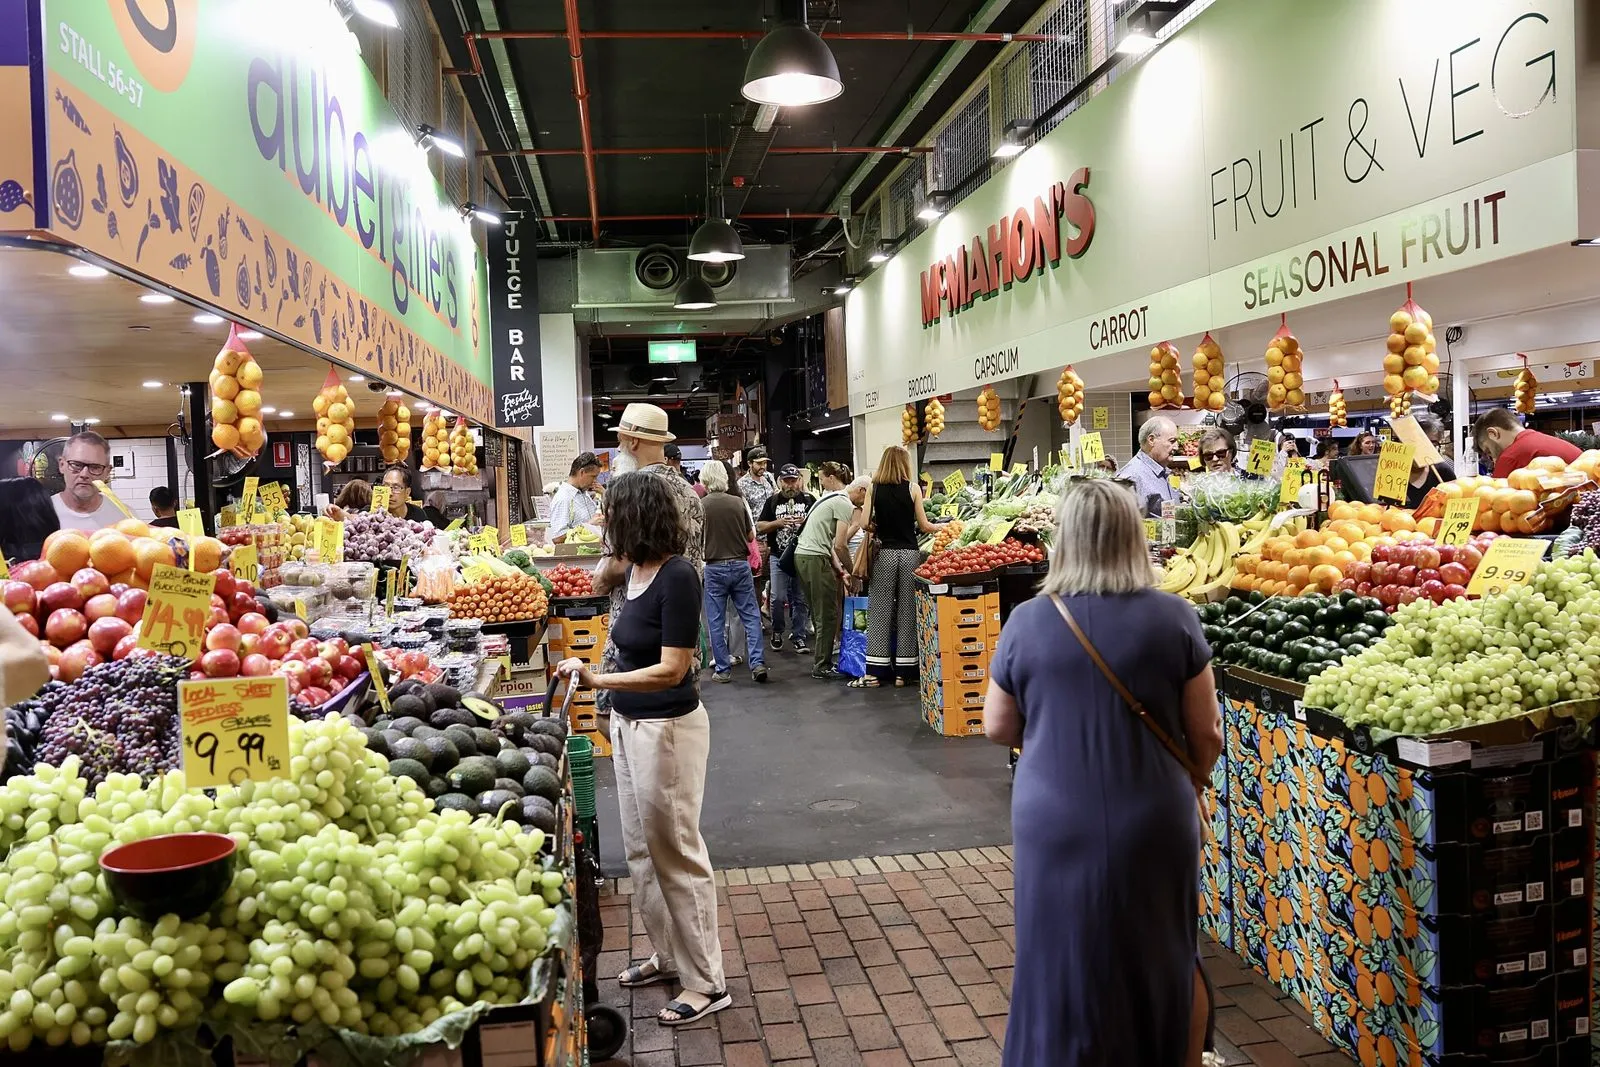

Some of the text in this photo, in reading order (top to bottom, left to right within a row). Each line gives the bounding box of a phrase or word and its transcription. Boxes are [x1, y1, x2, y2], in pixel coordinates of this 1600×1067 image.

[59, 22, 143, 108] STALL 56-57
[1211, 12, 1557, 241] FRUIT & VEG
[504, 220, 522, 309] JUICE
[1244, 190, 1506, 310] SEASONAL FRUIT
[1089, 305, 1149, 350] CARROT
[508, 329, 526, 381] BAR
[974, 346, 1019, 380] CAPSICUM
[908, 372, 937, 397] BROCCOLI
[154, 582, 172, 591] BLACK
[183, 685, 226, 704] LOCAL
